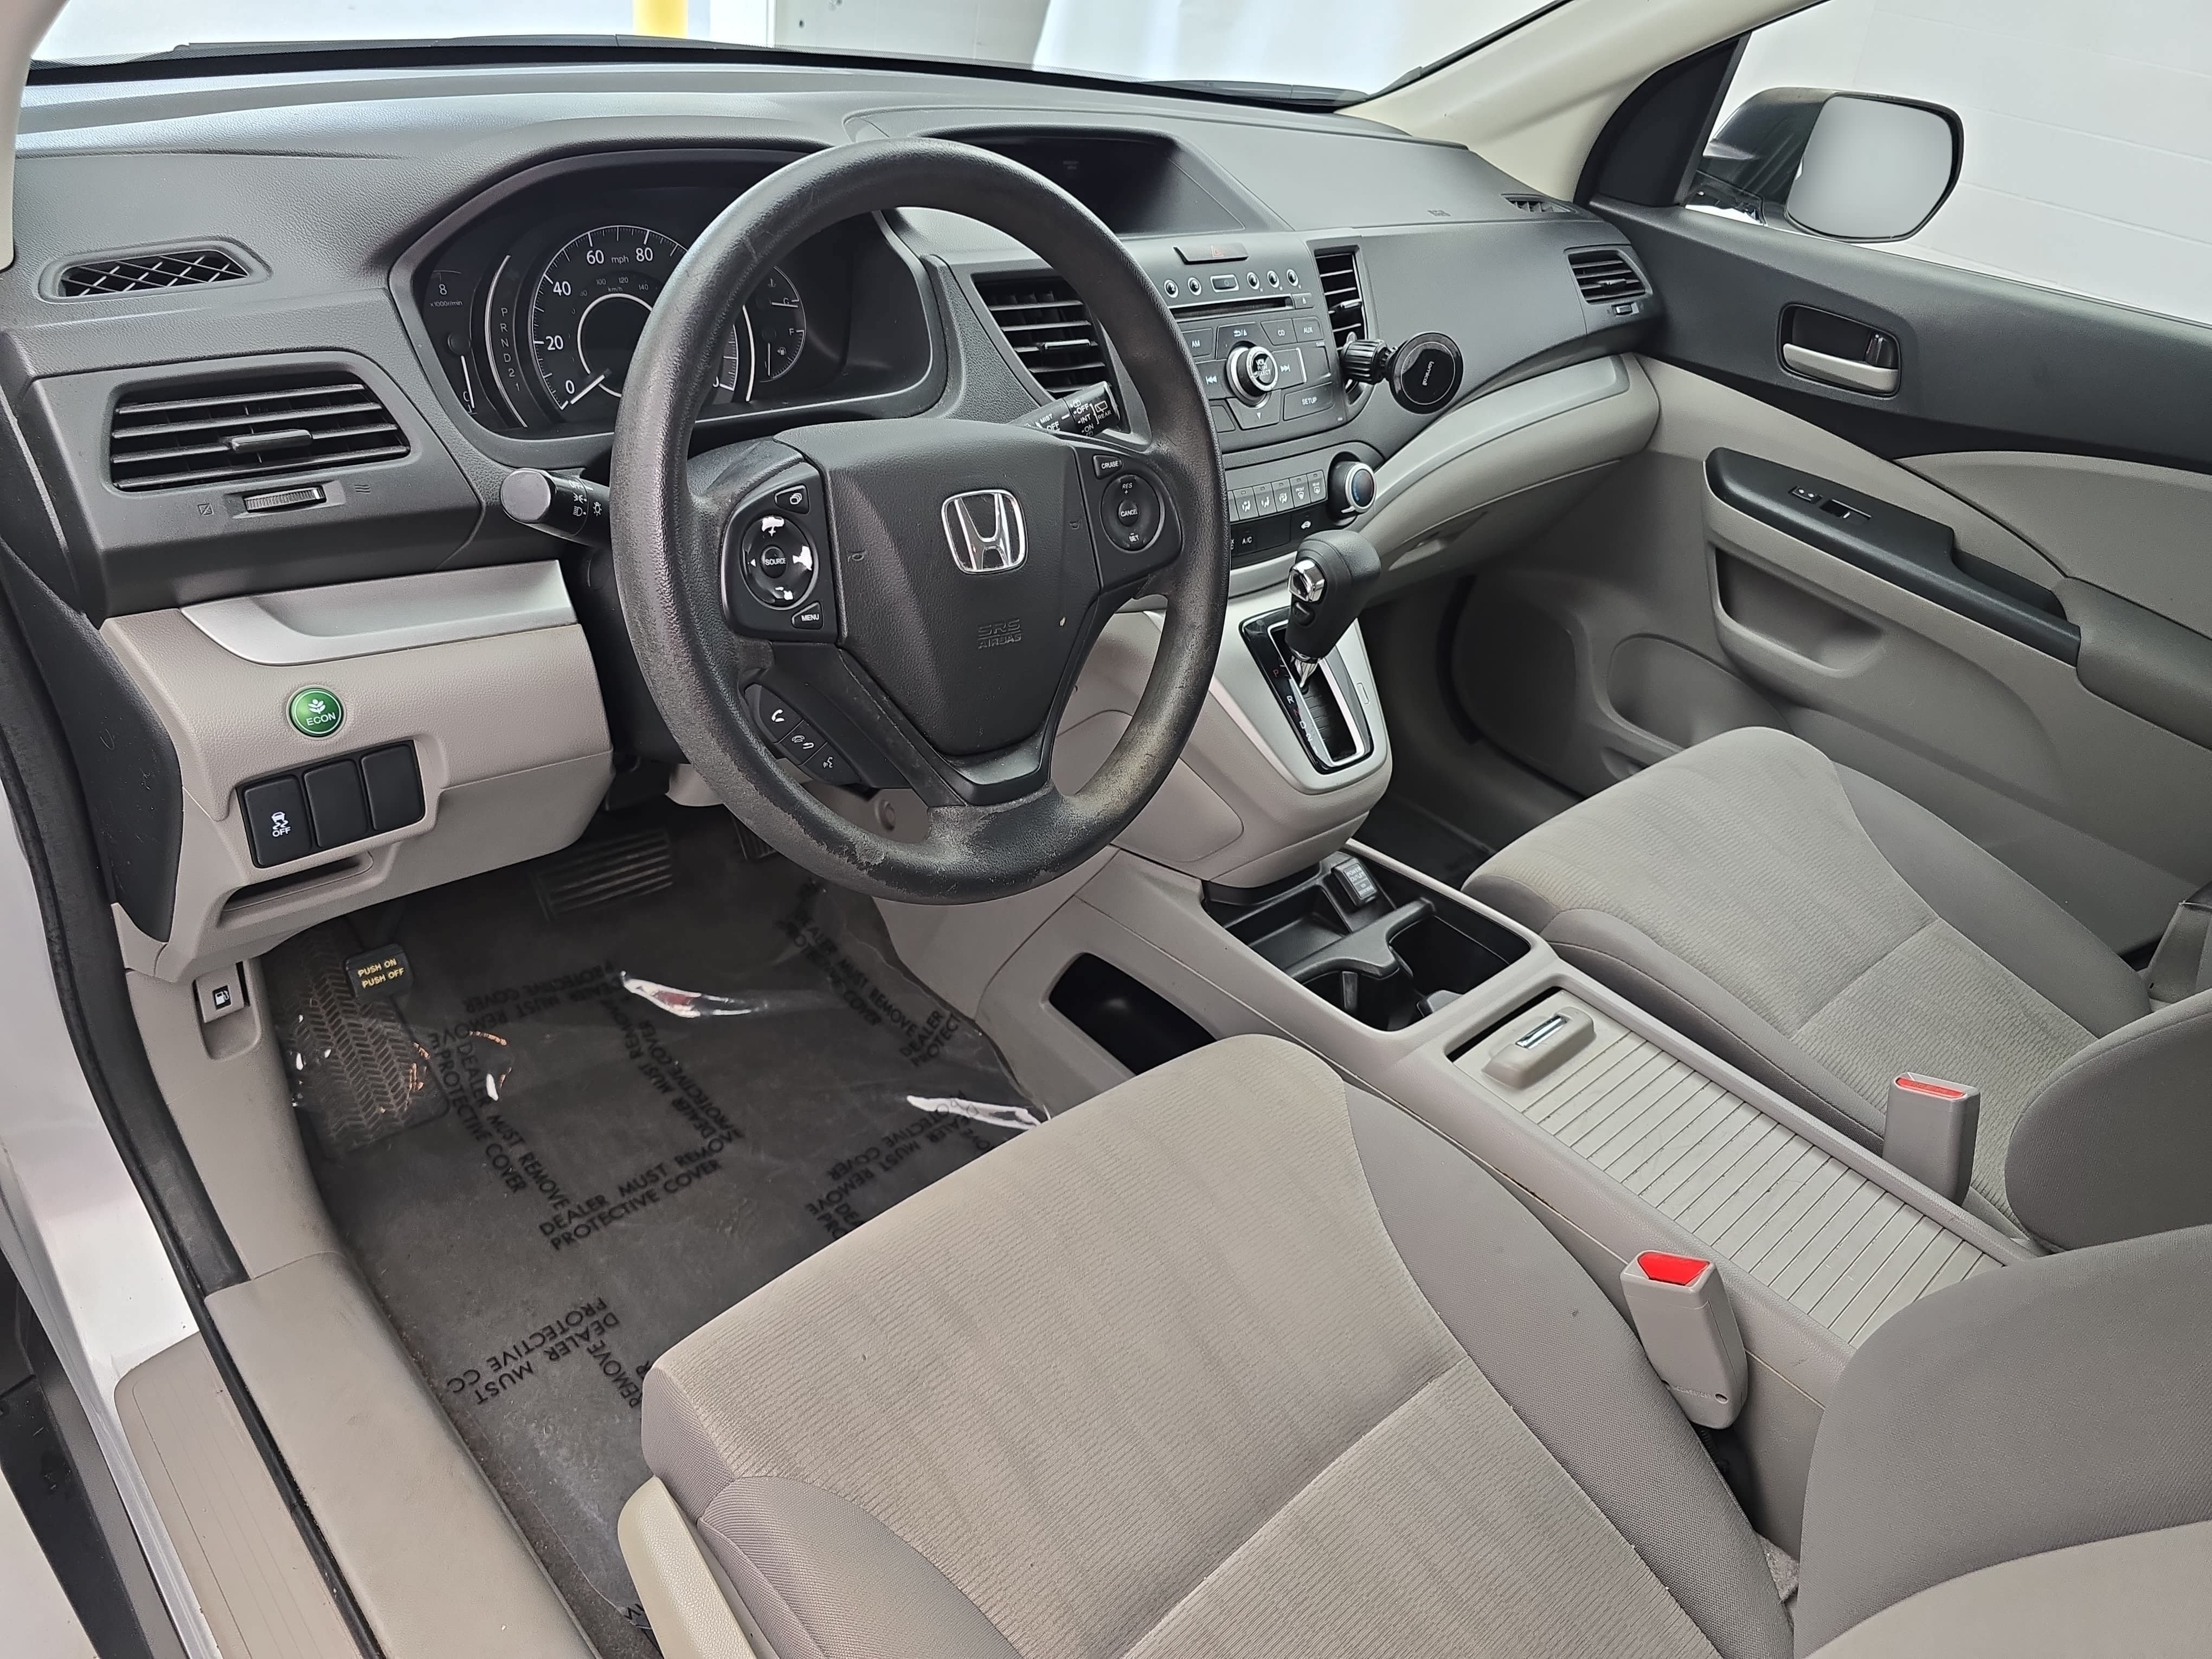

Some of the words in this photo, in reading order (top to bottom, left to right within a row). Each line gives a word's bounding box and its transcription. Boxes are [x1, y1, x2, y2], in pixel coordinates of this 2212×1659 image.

[586, 249, 605, 265] 60
[611, 255, 629, 264] mph
[635, 247, 653, 262] 80
[439, 284, 447, 295] 8
[552, 281, 571, 296] 40
[501, 308, 508, 317] P
[500, 323, 508, 332] R
[501, 338, 509, 348] N
[545, 335, 564, 350] 20
[504, 353, 511, 362] D
[509, 369, 516, 377] 2
[516, 383, 520, 391] 1
[565, 380, 575, 394] 0
[1302, 397, 1317, 406] SETUP
[1077, 403, 1089, 414] OFF
[1039, 413, 1053, 424] MIST
[1080, 414, 1092, 424] INT
[1098, 410, 1112, 420] REAR
[1046, 421, 1059, 430] OFF
[1084, 423, 1094, 432] ON
[1101, 461, 1118, 470] CRUISE
[1121, 509, 1138, 517] CANCEL
[1242, 536, 1252, 545] A/C
[978, 619, 1020, 637] SRS
[1273, 669, 1279, 677] P
[1287, 696, 1294, 704] R
[306, 712, 336, 726] ECON
[1299, 721, 1307, 729] D
[1306, 733, 1313, 742] 2
[272, 827, 291, 837] OFF
[358, 963, 382, 978] PUSH
[384, 958, 397, 968] ON
[362, 974, 387, 988] PUSH
[388, 968, 404, 979] OFF
[869, 988, 917, 1038] REMOVE
[436, 1049, 492, 1143] PROTECTIVE
[485, 1143, 527, 1194] COVER
[879, 1139, 922, 1173] MUST
[487, 1113, 526, 1149] MUST
[518, 1150, 570, 1211] REMOVE
[805, 1168, 876, 1216] REMOVE
[539, 1193, 610, 1237] DEALER
[618, 1163, 670, 1198] MUST
[549, 1191, 661, 1251] PROTECTIVE
[663, 1158, 724, 1194] COVER
[486, 1297, 607, 1373] PROTECTIVE
[544, 1312, 619, 1361] DEALER
[587, 1340, 642, 1409] REMOVE
[474, 1360, 534, 1405] MUST
